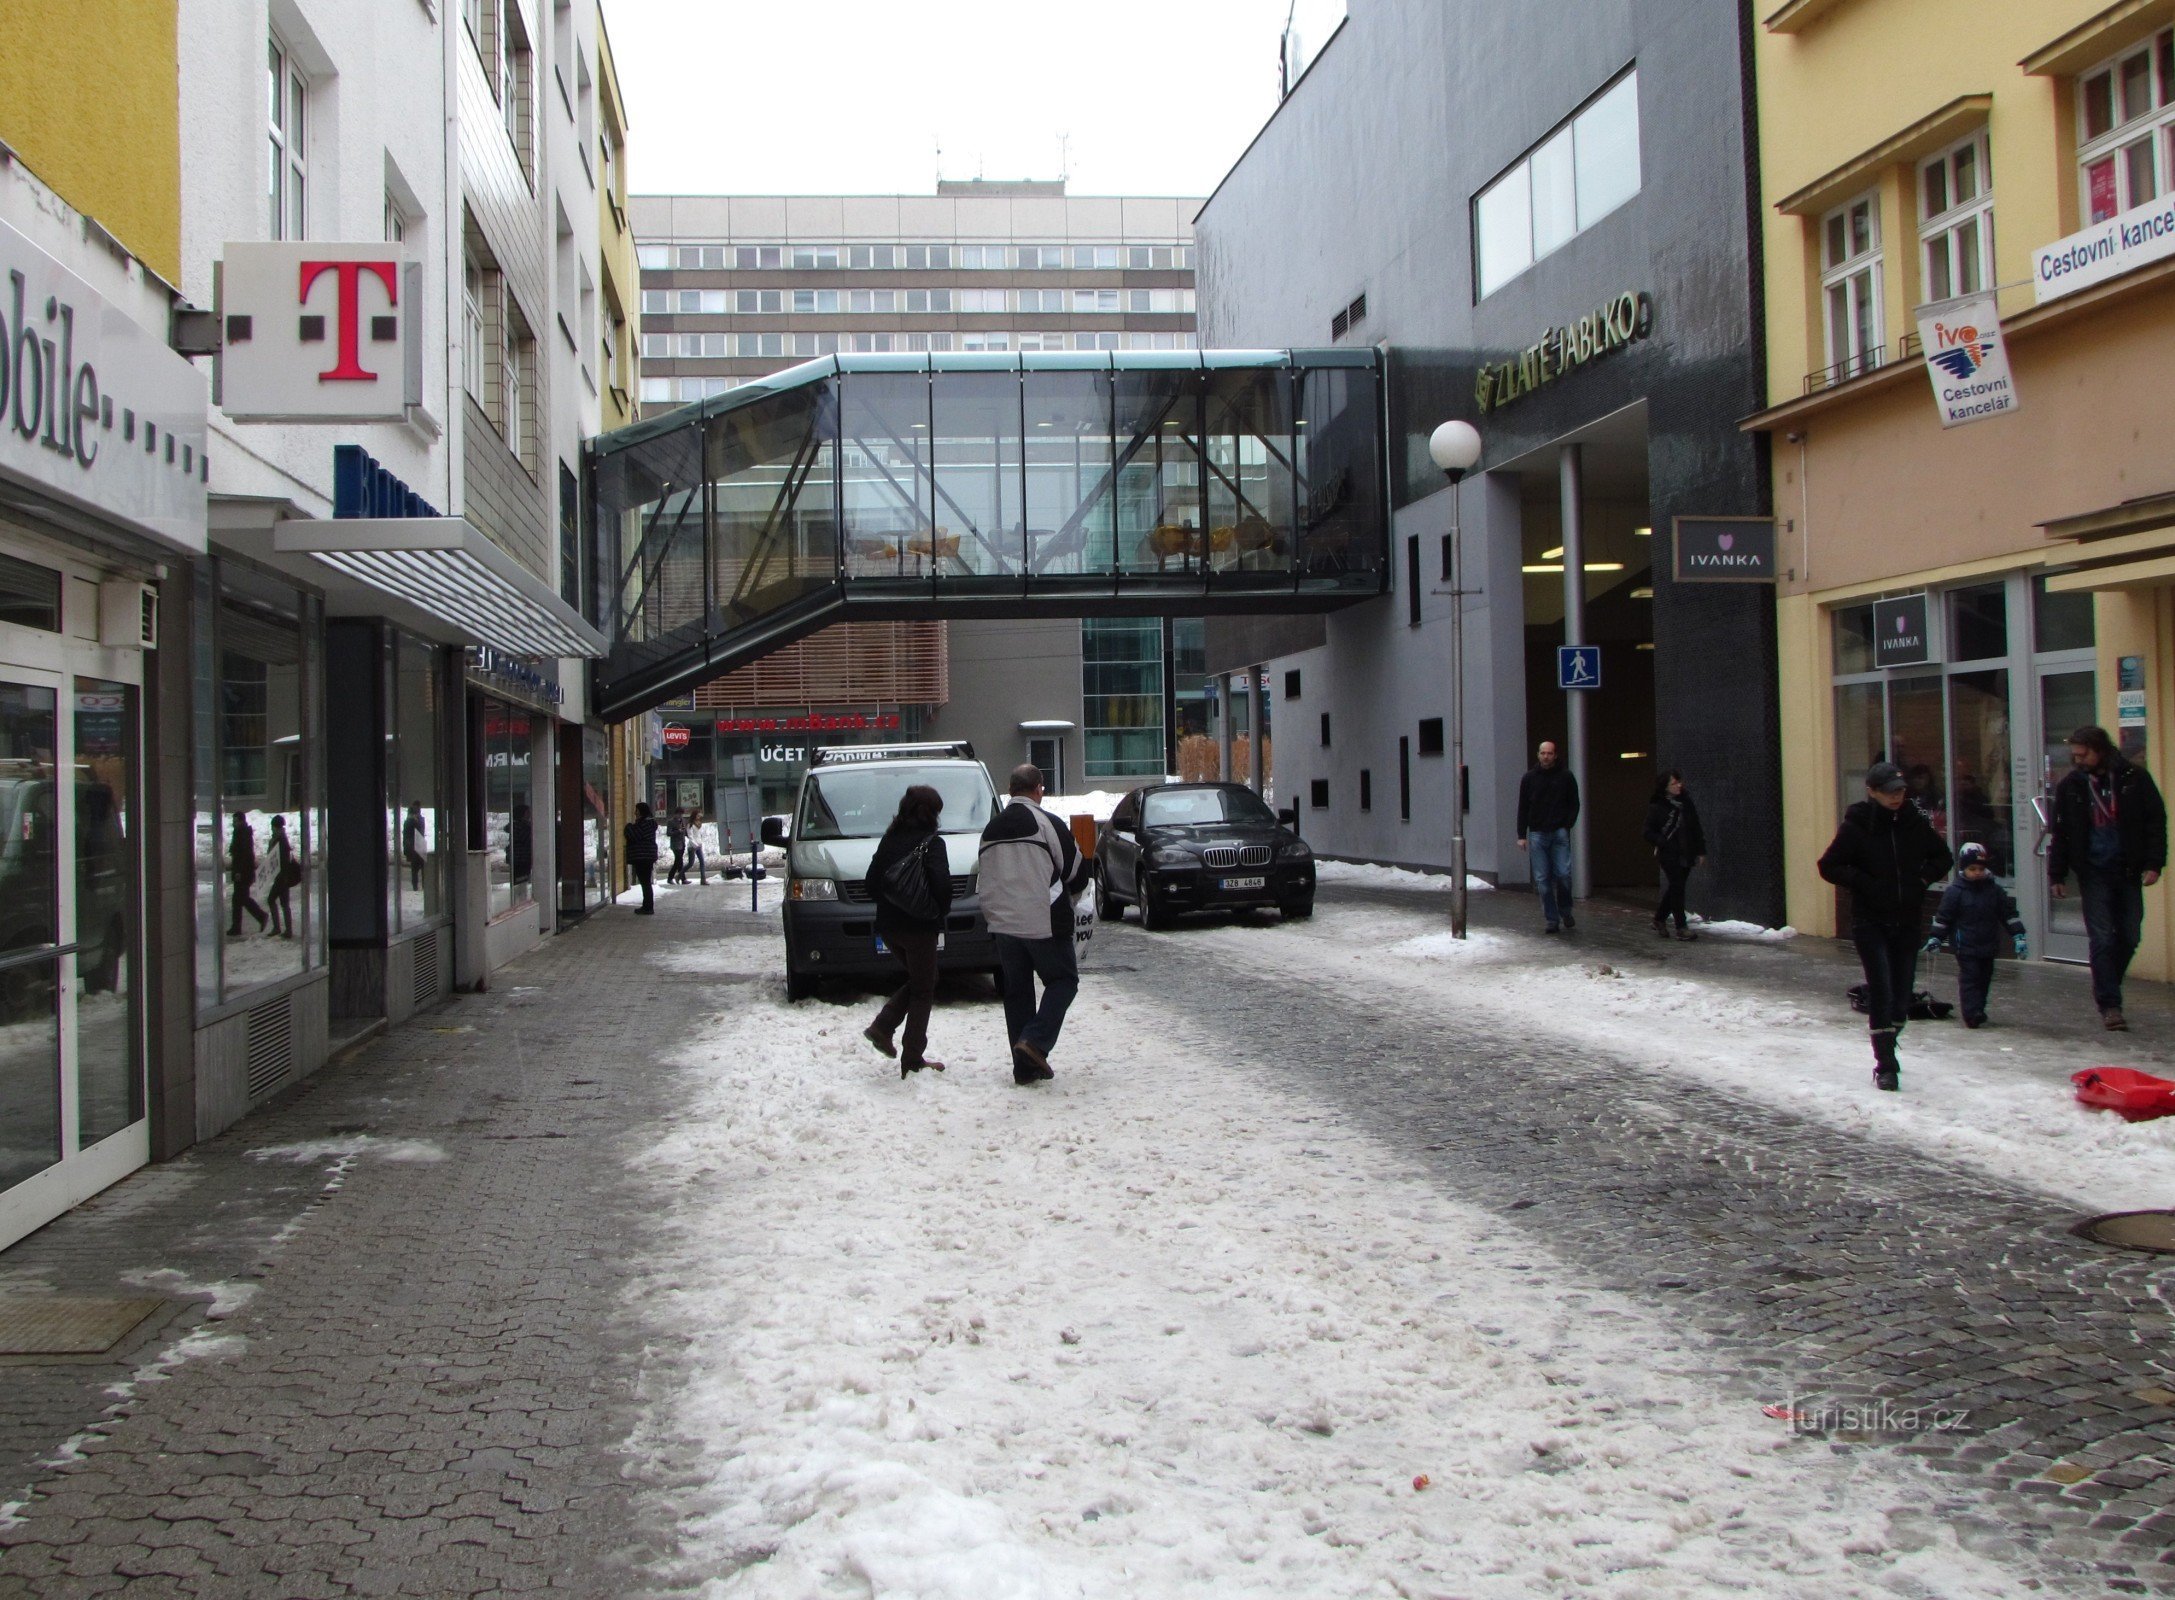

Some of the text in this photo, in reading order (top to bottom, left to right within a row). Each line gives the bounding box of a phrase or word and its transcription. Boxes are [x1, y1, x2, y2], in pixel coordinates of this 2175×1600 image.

[2040, 202, 2175, 281] Cestovní kance
[299, 260, 398, 381] T
[1495, 290, 1638, 408] ZLATÉ JABLKO
[1943, 376, 2008, 402] Cestovní
[1948, 395, 2011, 420] kancelář
[1690, 554, 1761, 567] IVANKA
[1883, 635, 1920, 650] IVANKA
[760, 744, 805, 762] ÚČET
[1076, 929, 1093, 942] YOU
